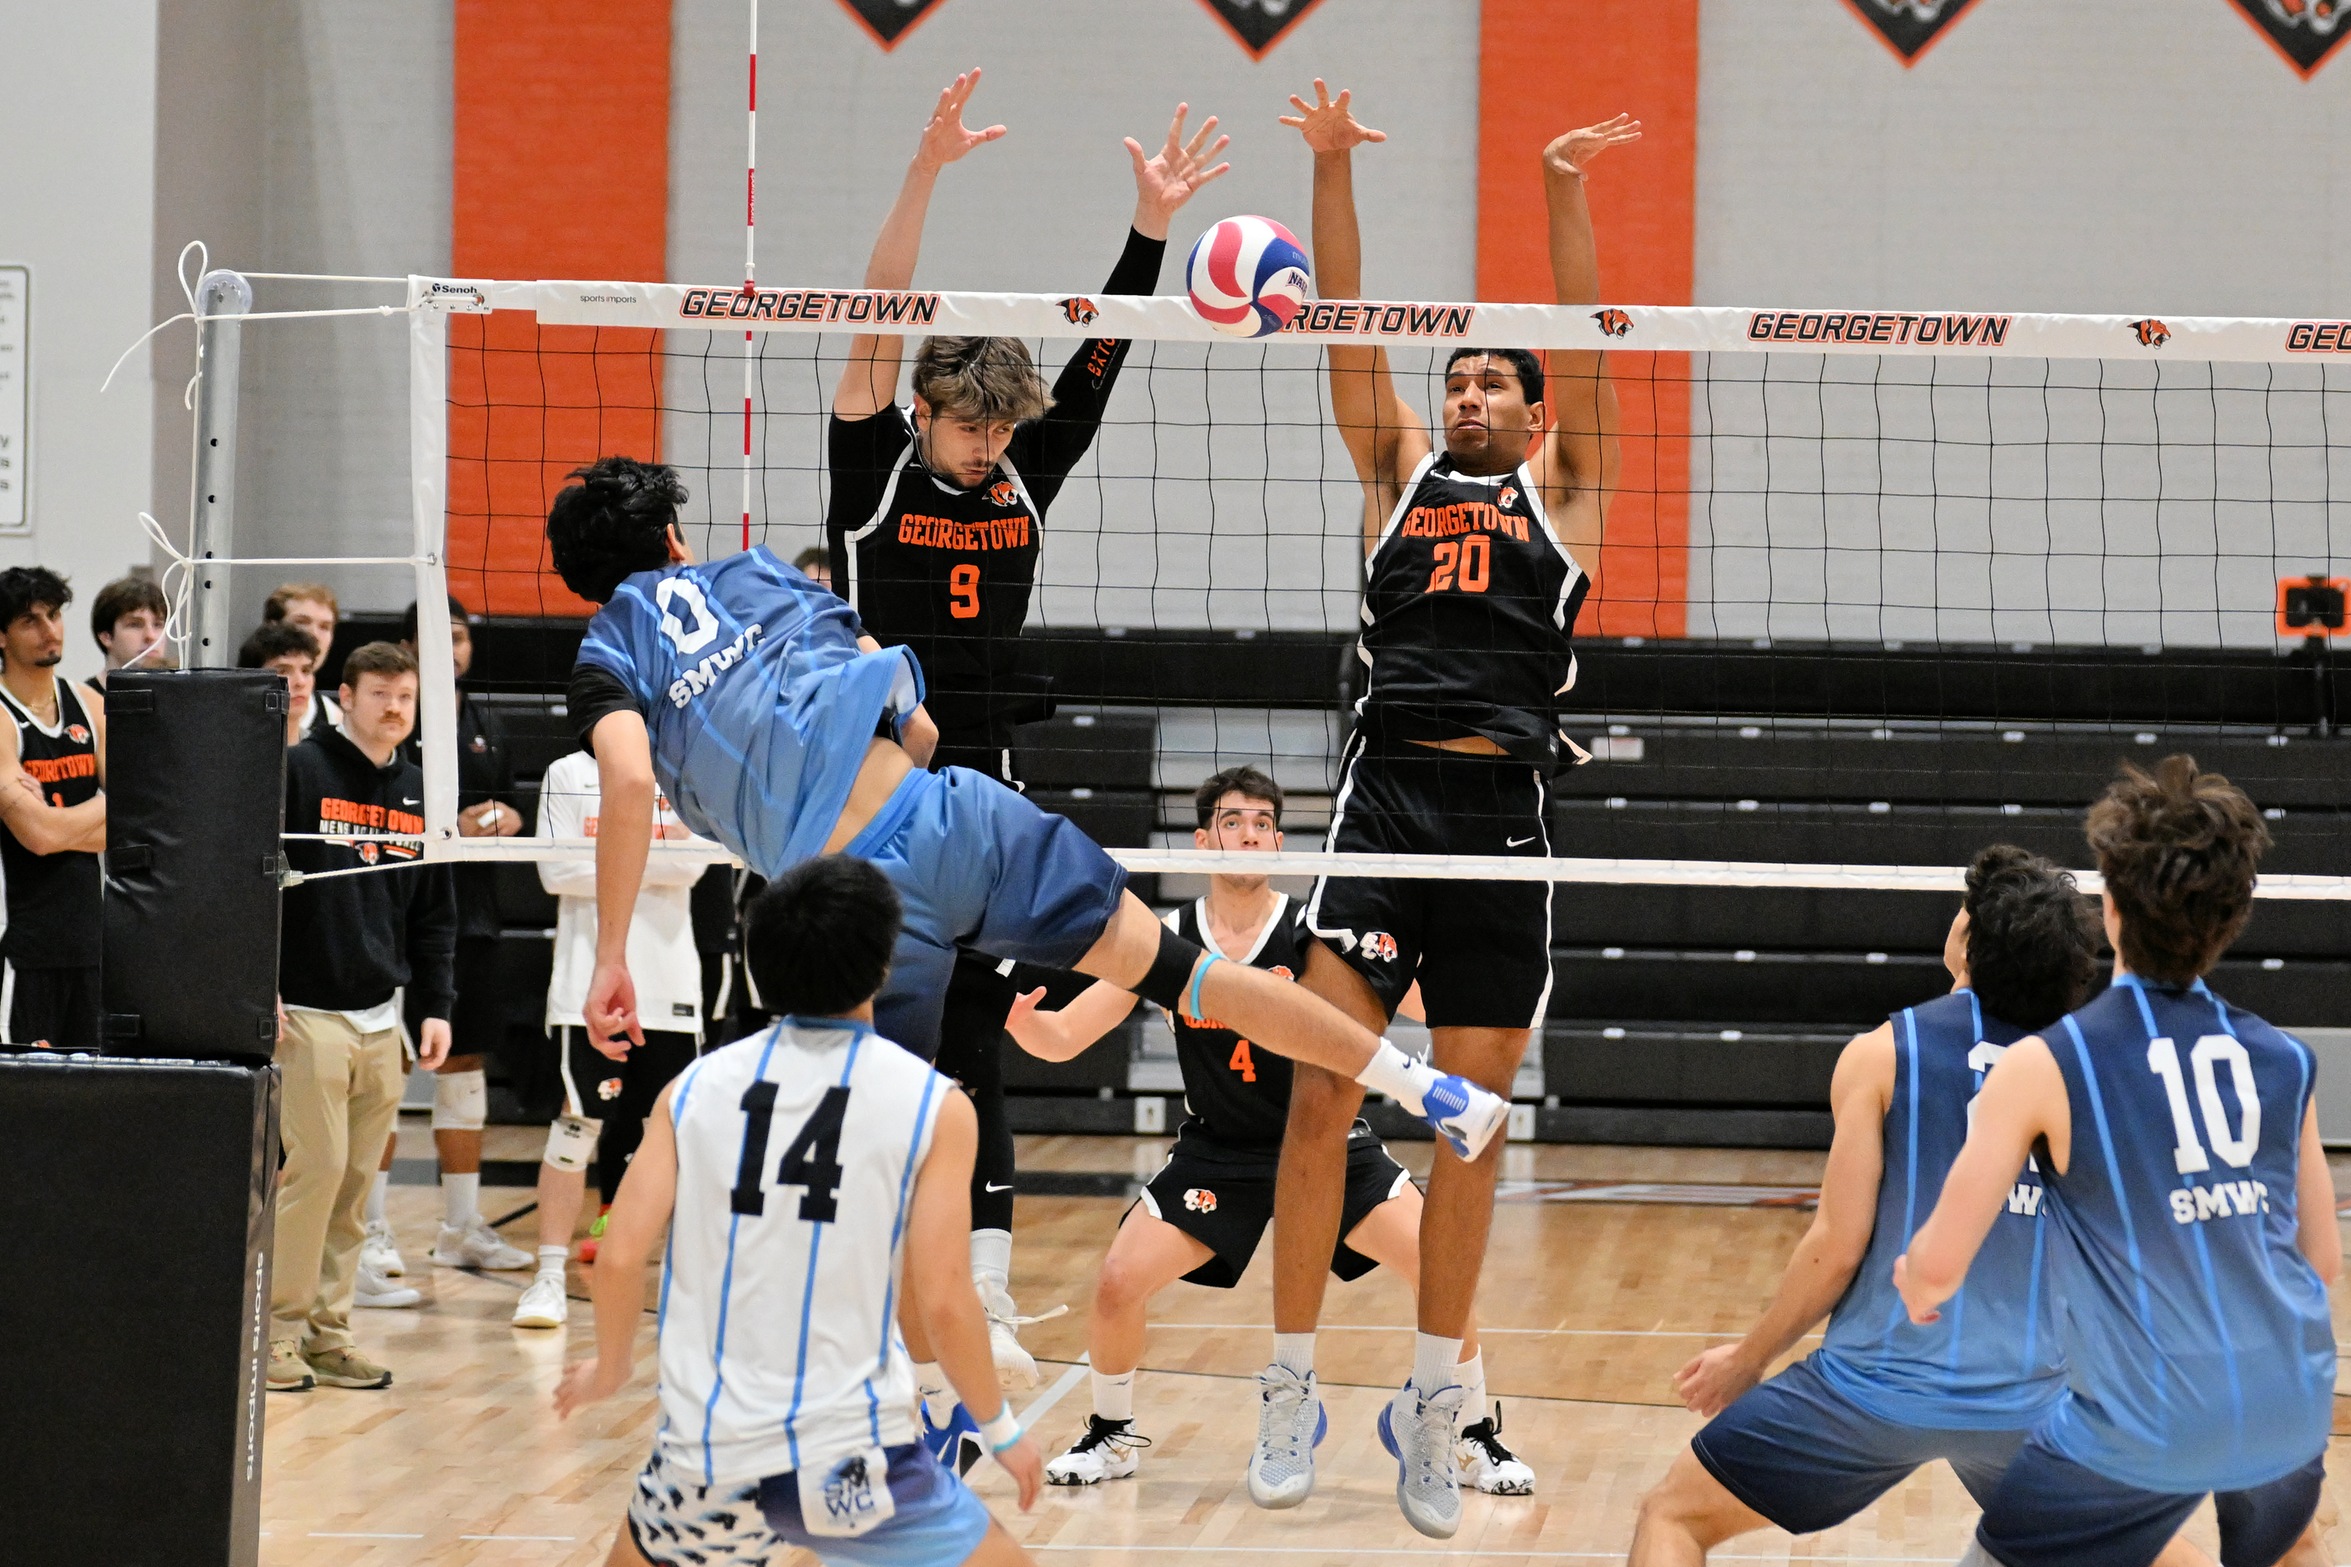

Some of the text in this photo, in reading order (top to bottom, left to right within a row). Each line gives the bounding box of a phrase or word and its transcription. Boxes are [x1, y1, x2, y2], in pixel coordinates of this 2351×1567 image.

[441, 284, 478, 295] Senoh
[580, 294, 637, 304] sports imports
[679, 288, 941, 325] GEORGETOWN
[1284, 301, 1475, 338] RGETOWN
[1747, 311, 2012, 346] GEORGETOWN
[898, 513, 1031, 551] GEORGETOWN
[1401, 501, 1531, 543] GEORGETOWN
[1424, 534, 1492, 594] 20
[950, 563, 981, 619] 9
[655, 576, 720, 655] 0
[668, 622, 767, 709] SMWC
[22, 753, 96, 783] GEORTOWN
[1229, 1039, 1257, 1082] 4
[2146, 1034, 2263, 1175] 10
[730, 1078, 851, 1223] 14
[246, 1251, 264, 1483] sports imports
